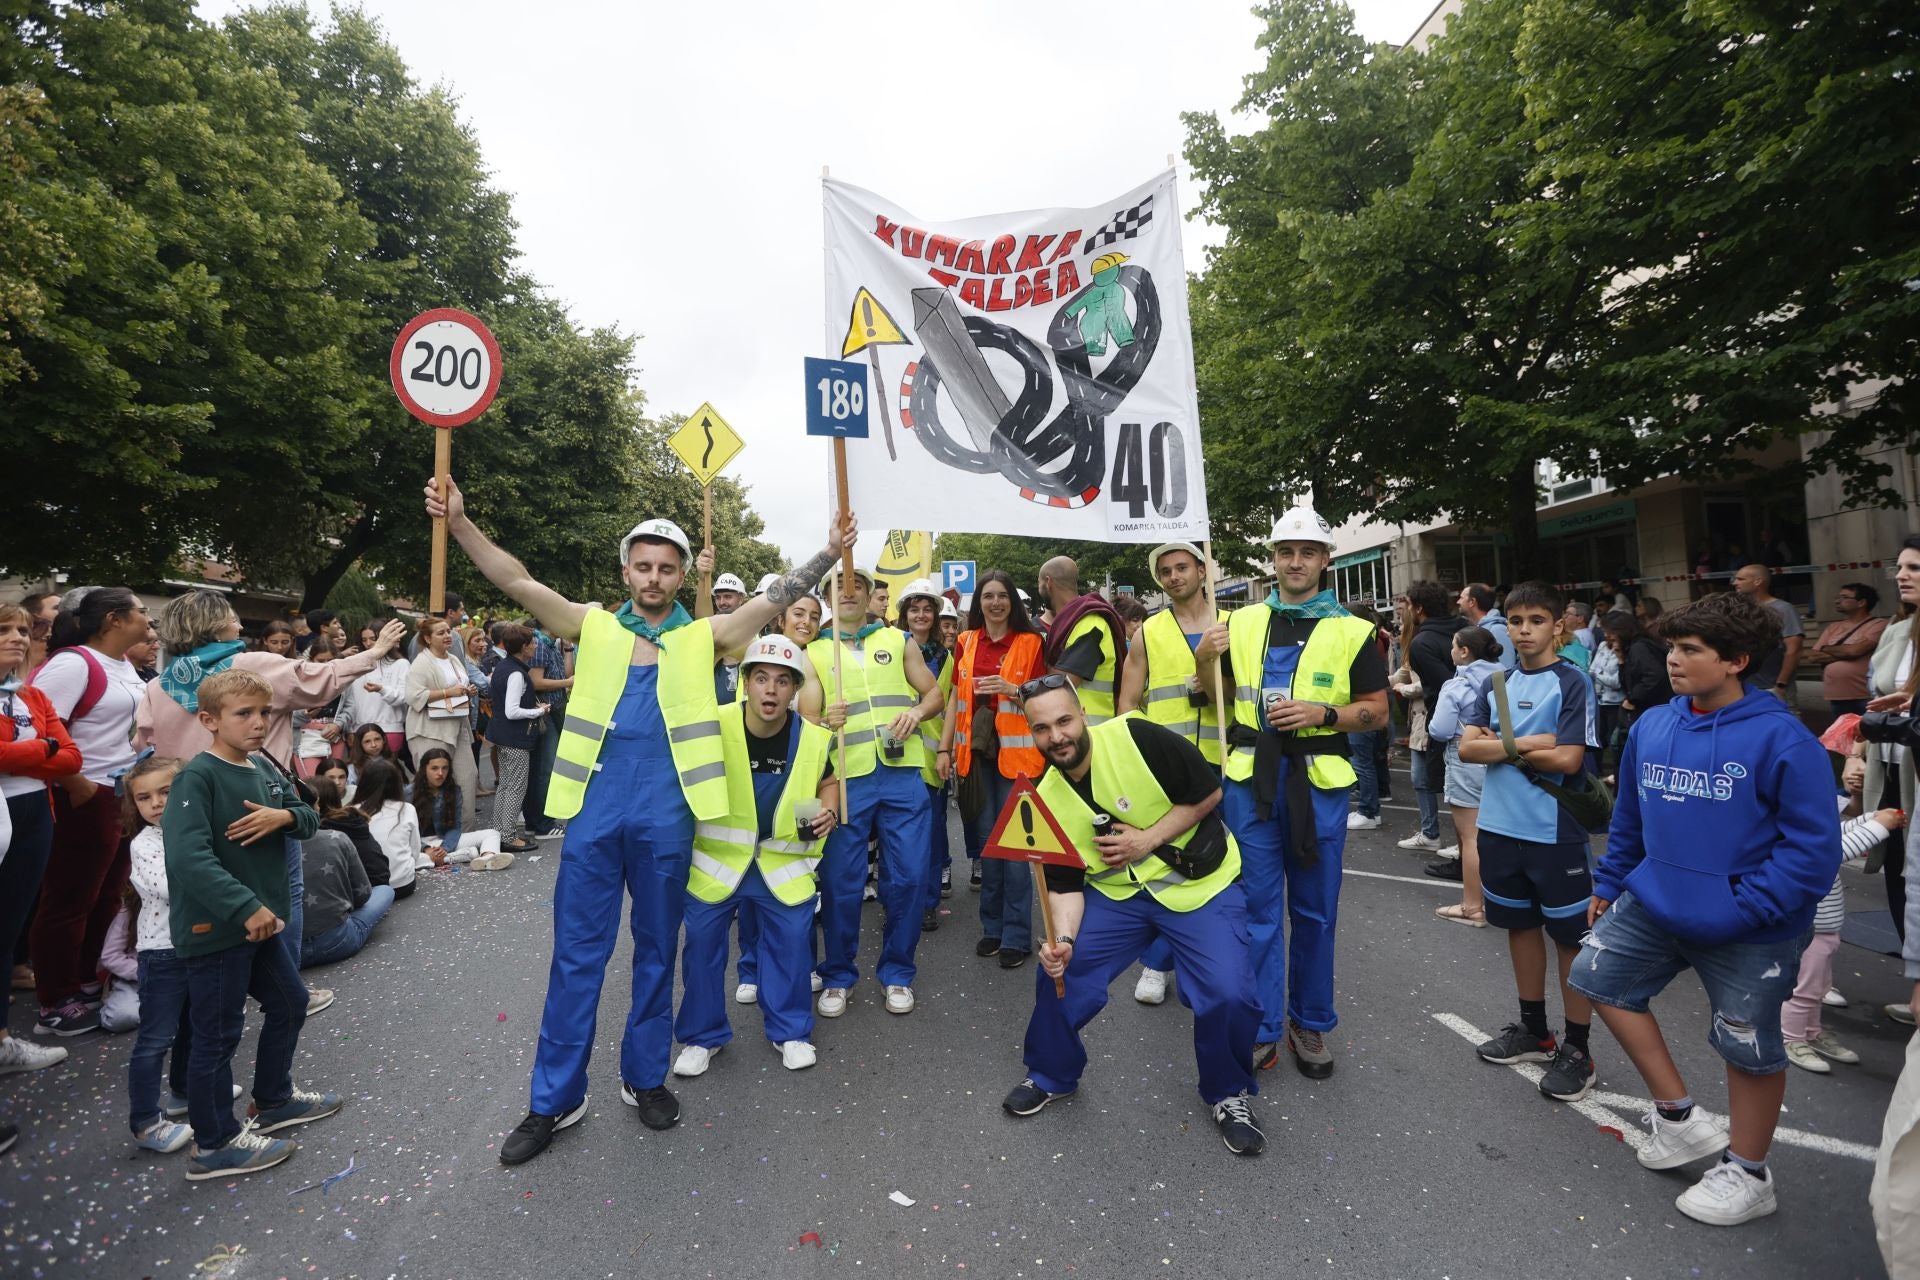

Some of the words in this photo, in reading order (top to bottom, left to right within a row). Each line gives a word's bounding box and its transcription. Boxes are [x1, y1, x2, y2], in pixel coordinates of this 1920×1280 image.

[873, 214, 1083, 275] KOMARKA
[927, 260, 1081, 312] TALDEA
[410, 340, 482, 390] 200
[817, 377, 864, 420] 180
[1110, 421, 1188, 519] 40
[653, 524, 673, 536] KT
[1114, 523, 1155, 532] KOMARKA
[1157, 521, 1189, 530] TALDEA
[720, 578, 737, 586] CAPO
[948, 564, 969, 588] P
[1642, 762, 1733, 801] ADIDAS
